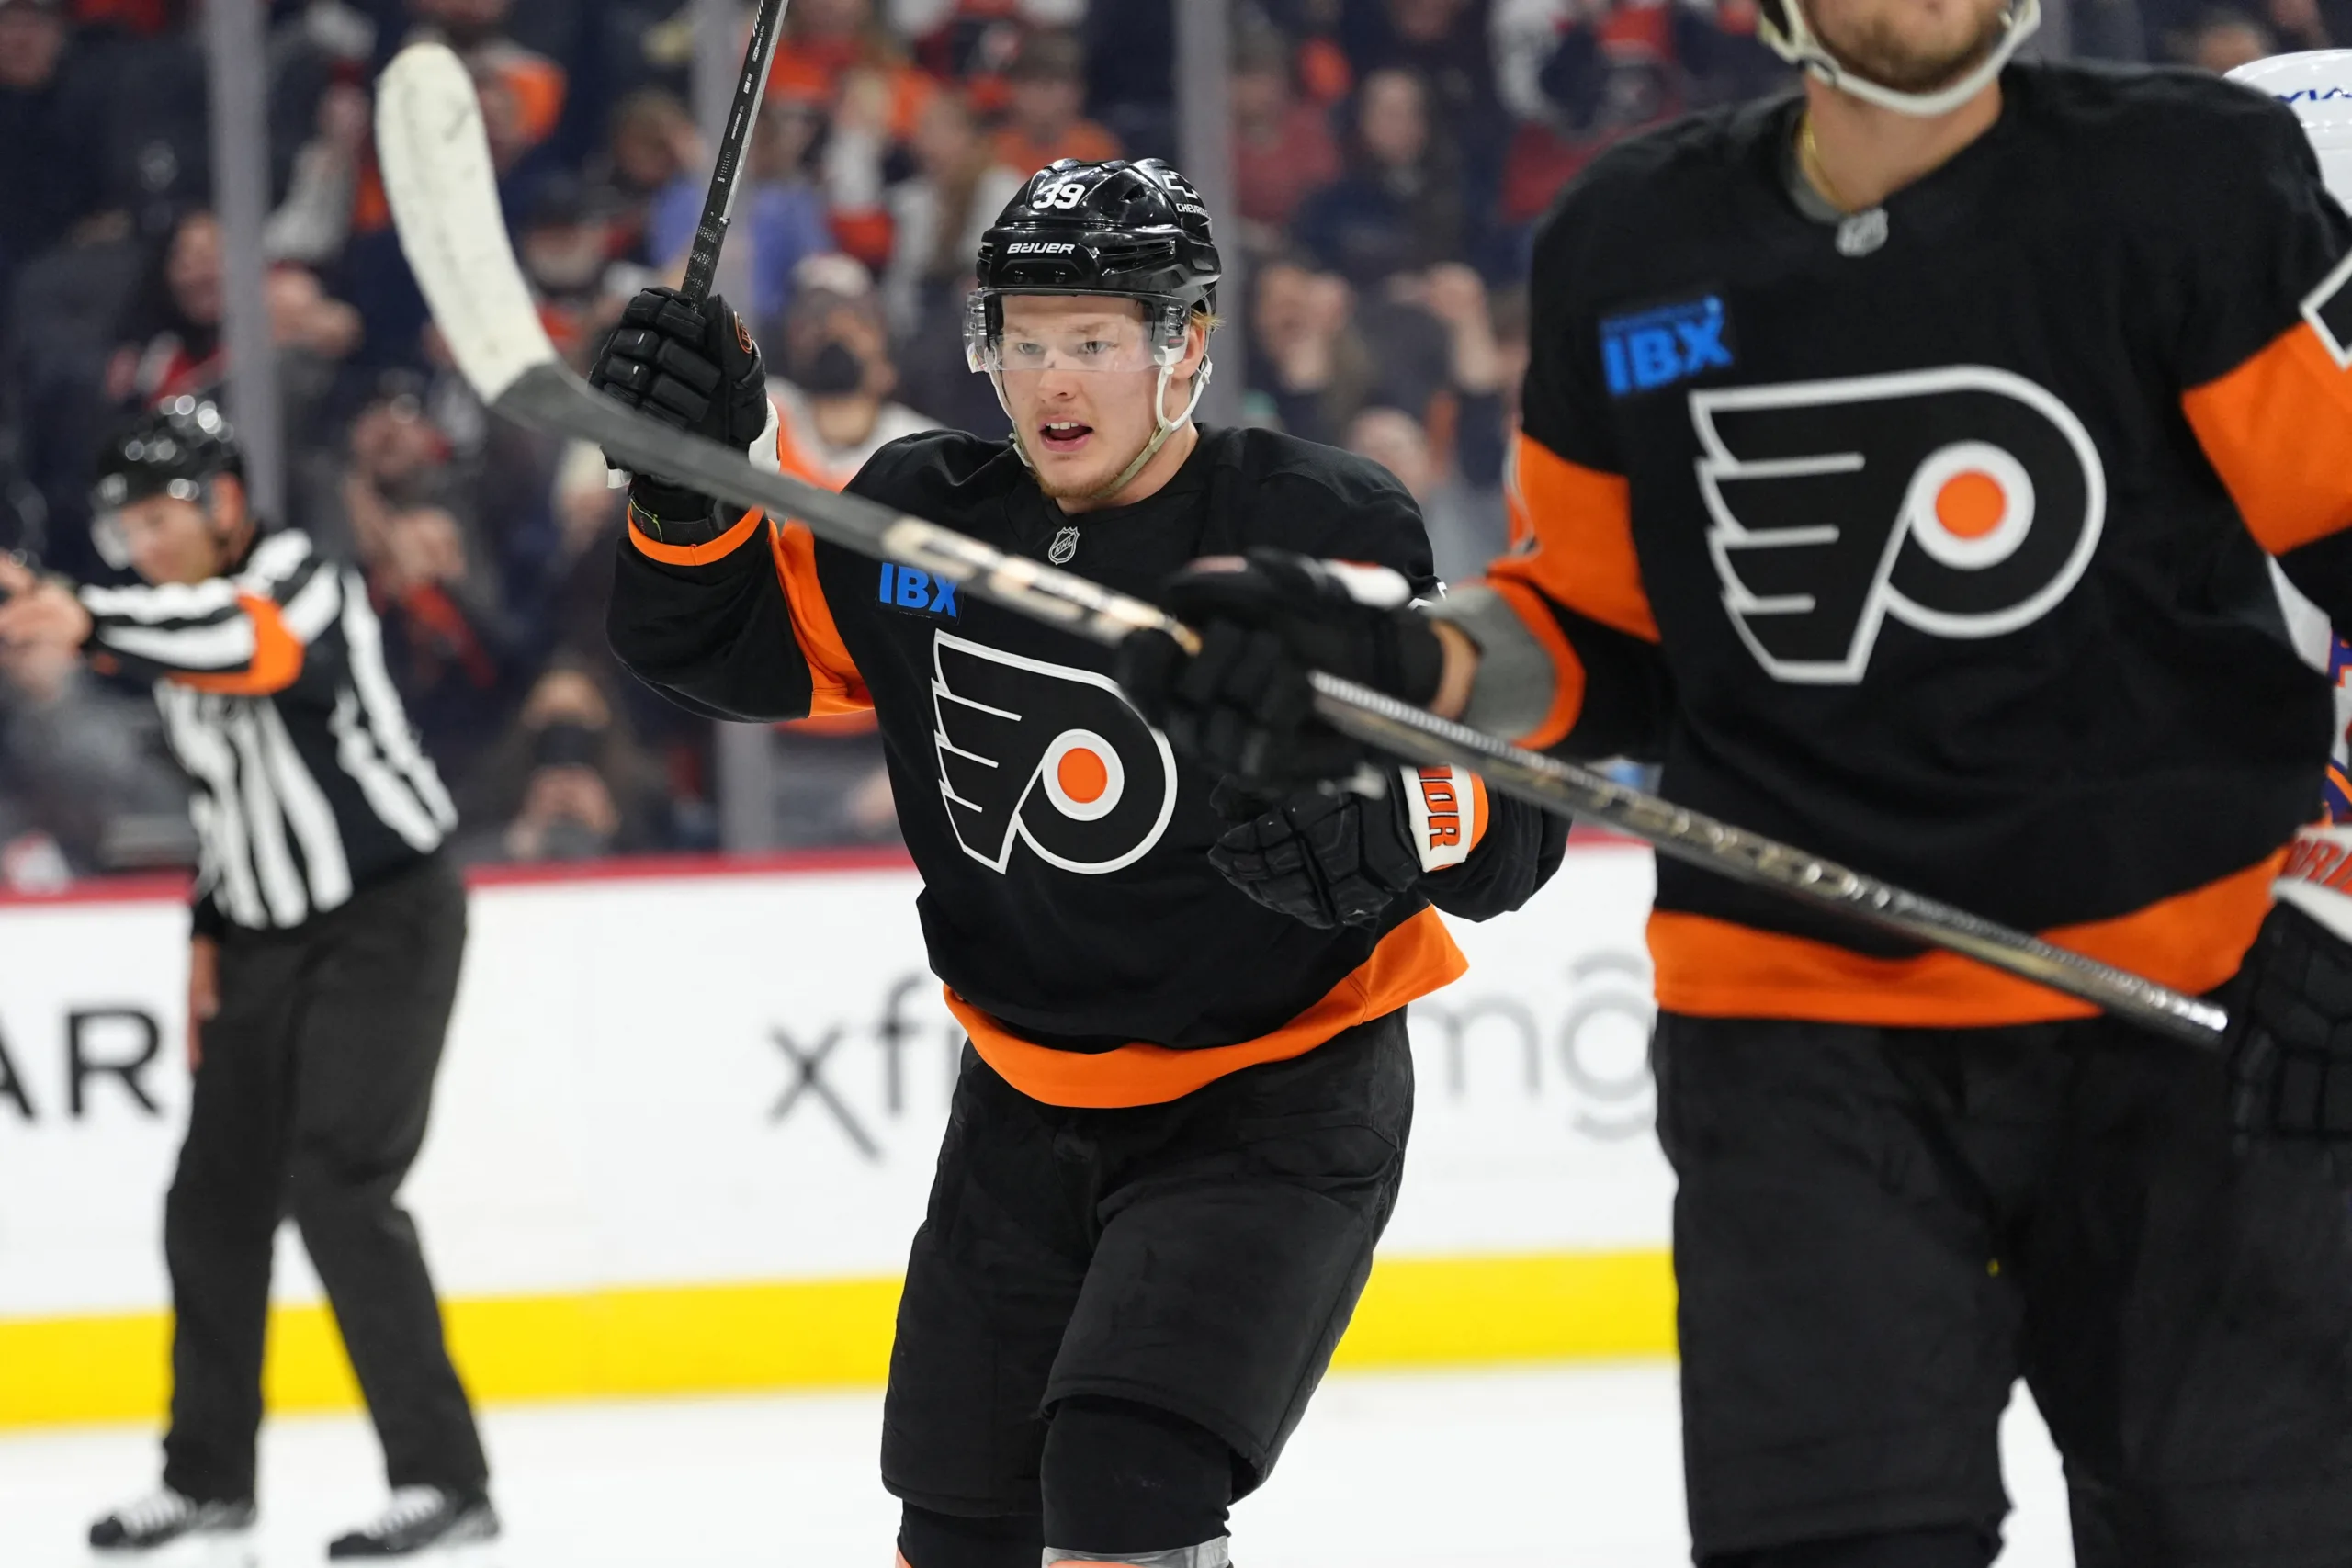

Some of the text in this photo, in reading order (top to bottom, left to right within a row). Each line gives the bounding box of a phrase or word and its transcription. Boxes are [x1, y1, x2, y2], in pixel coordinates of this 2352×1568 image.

[1032, 184, 1086, 209] 39
[1007, 243, 1076, 254] BAUER
[1603, 296, 1735, 396] IBX
[1053, 536, 1073, 557] NHL
[878, 561, 958, 618] IBX
